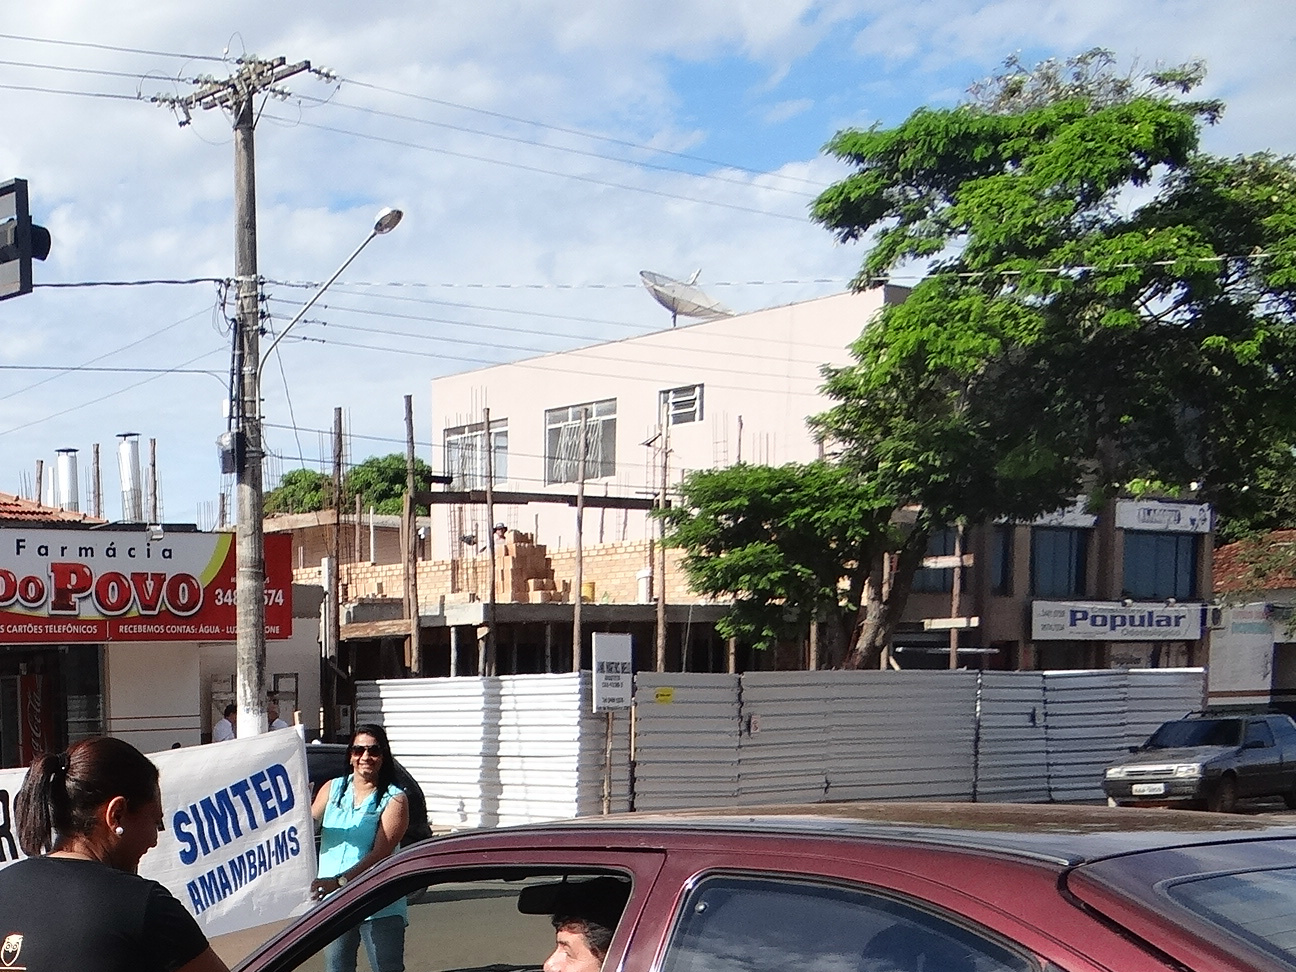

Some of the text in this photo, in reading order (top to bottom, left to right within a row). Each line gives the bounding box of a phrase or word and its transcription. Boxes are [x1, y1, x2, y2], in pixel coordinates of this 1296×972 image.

[15, 539, 173, 559] Farmácia
[6, 622, 43, 634] CARTÕES
[44, 622, 98, 634] TELEFÔNICOS
[119, 625, 165, 634] RECEBEMOS
[199, 622, 220, 634] ÁGUA
[1068, 609, 1187, 631] Popular
[172, 763, 295, 866] SIMTED
[186, 825, 301, 916] AMAMBAI-MS
